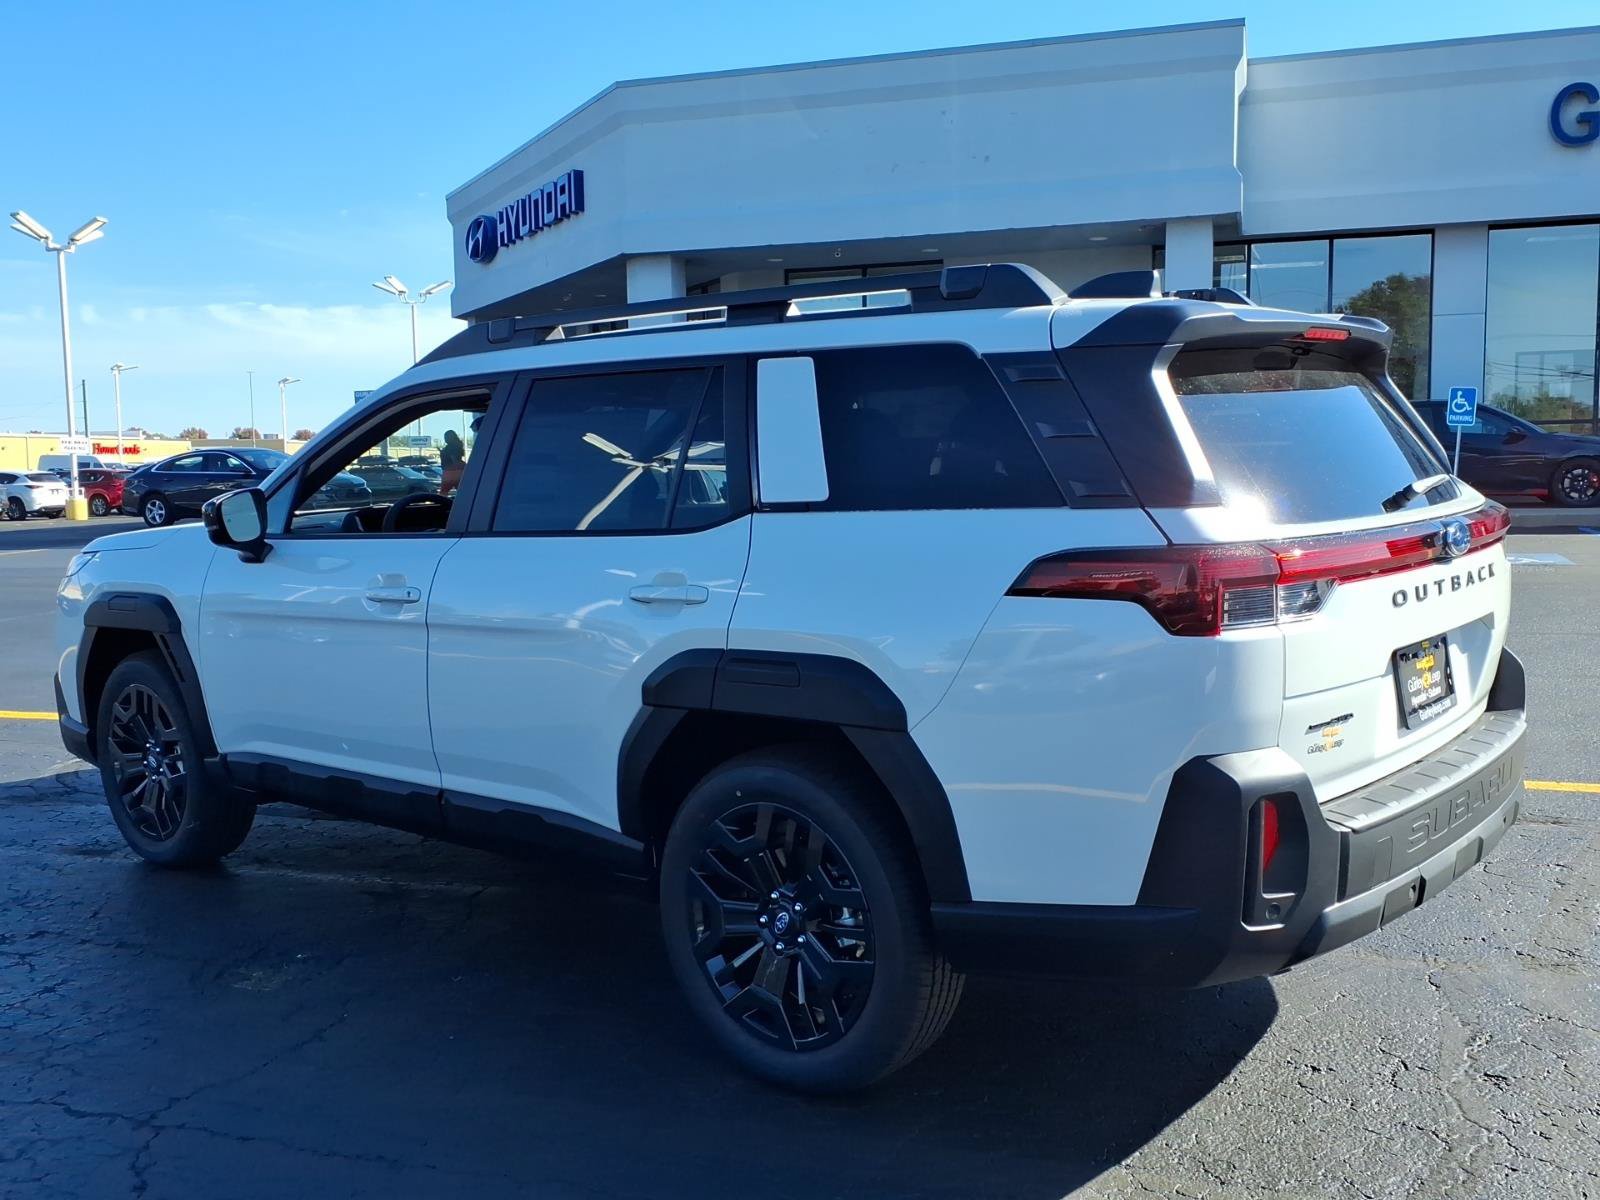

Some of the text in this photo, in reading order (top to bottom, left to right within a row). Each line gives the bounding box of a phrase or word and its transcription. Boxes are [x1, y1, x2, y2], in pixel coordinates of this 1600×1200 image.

[1549, 81, 1600, 147] G
[497, 169, 585, 247] HYUNDAI
[1392, 562, 1496, 609] OUTBACK
[1406, 756, 1514, 854] SUBARU
